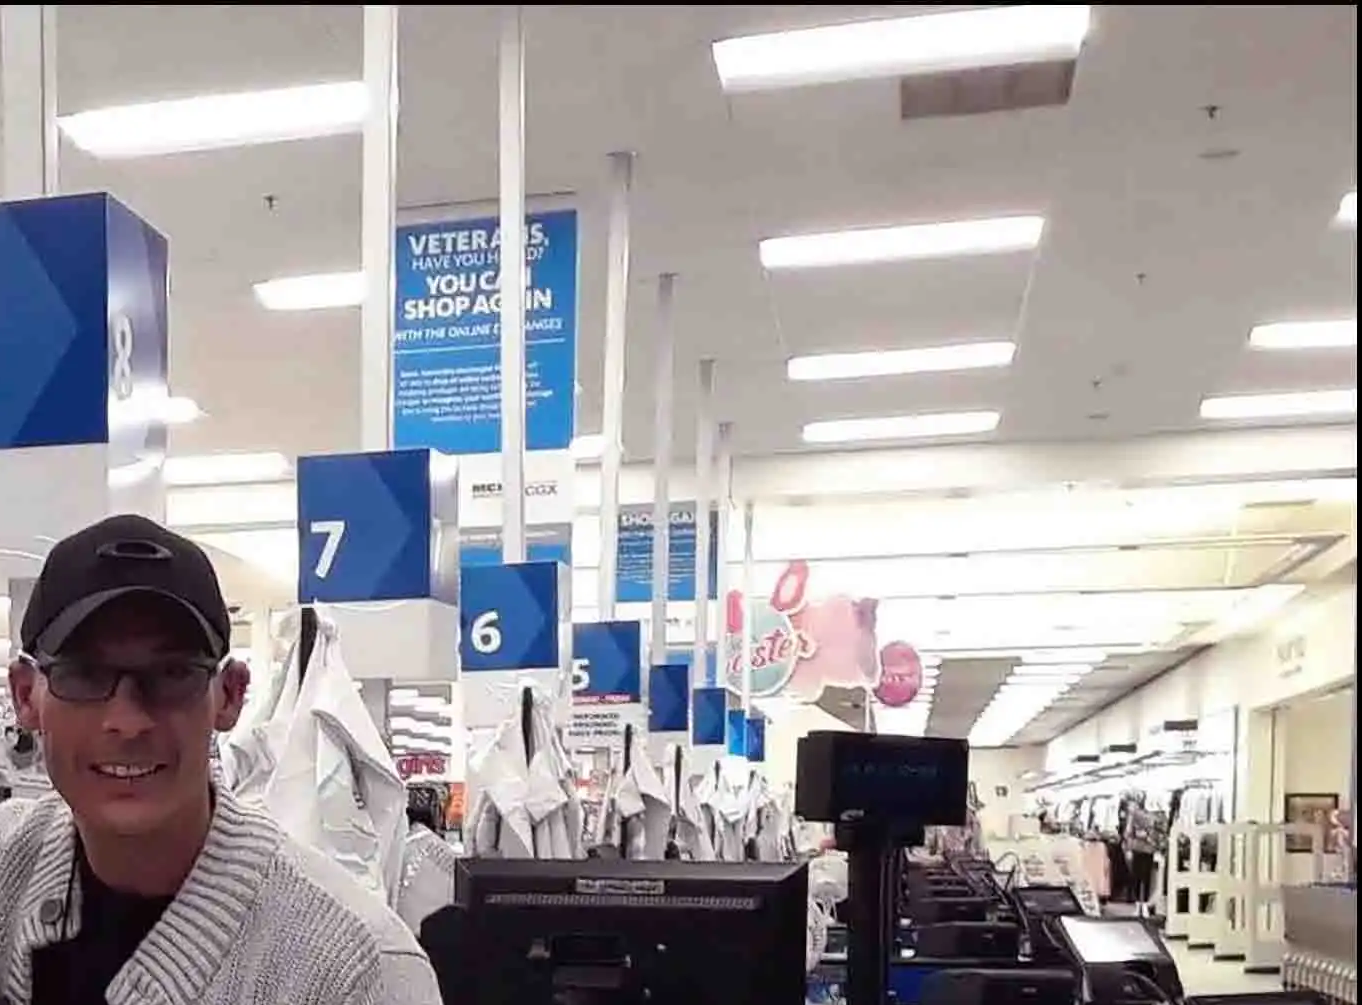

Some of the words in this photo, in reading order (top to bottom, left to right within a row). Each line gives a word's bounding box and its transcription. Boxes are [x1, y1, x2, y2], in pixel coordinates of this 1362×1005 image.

[409, 223, 549, 255] VETERAS,
[412, 254, 449, 271] HAVE
[453, 252, 485, 268] YOU
[426, 273, 478, 295] YOU
[404, 296, 471, 320] SHOP
[472, 288, 552, 314] AGIN
[113, 316, 135, 400] 8
[310, 519, 346, 580] 7
[470, 611, 502, 654] 6
[572, 658, 591, 692] 5
